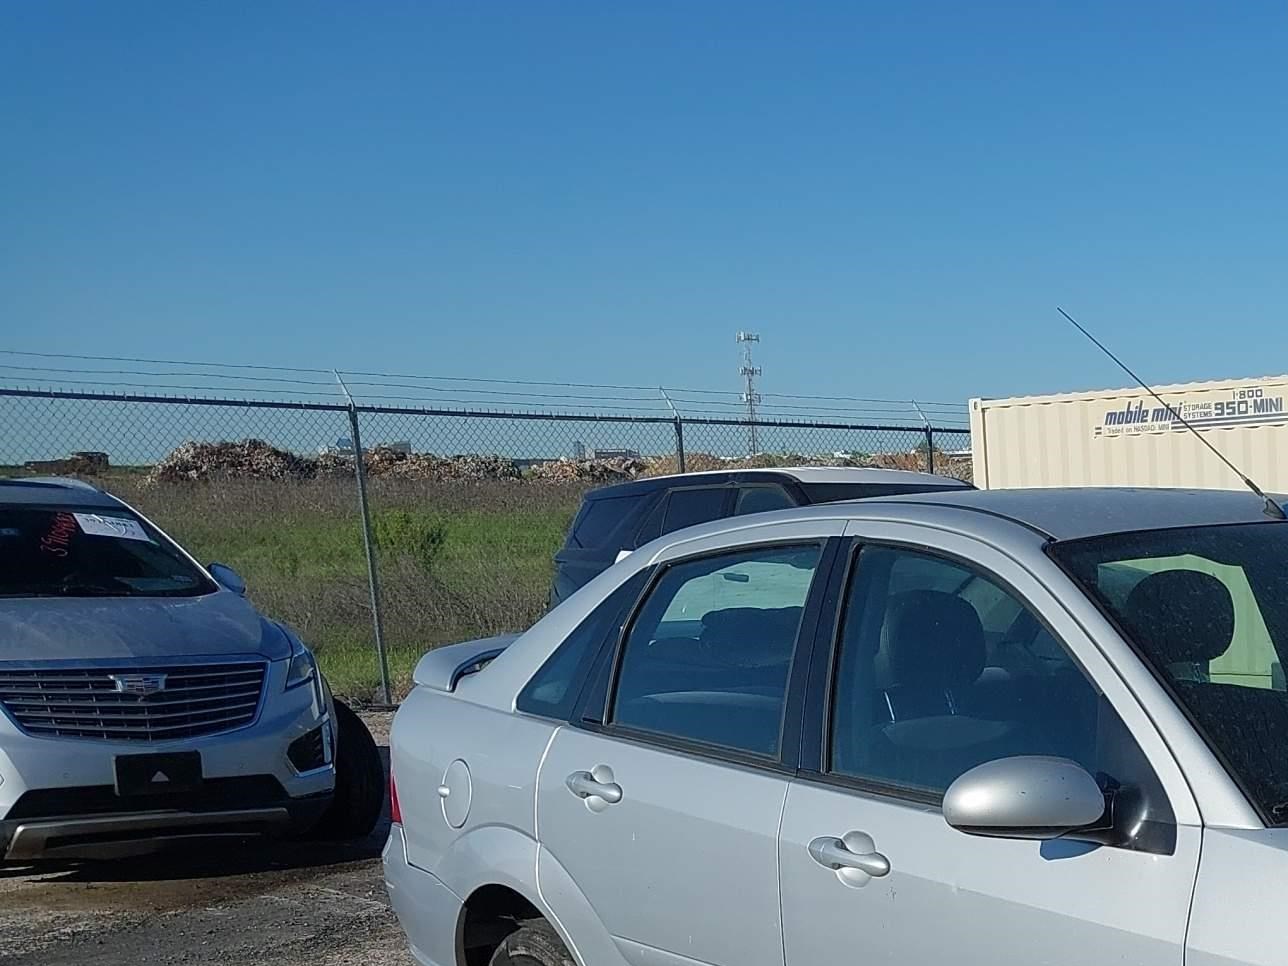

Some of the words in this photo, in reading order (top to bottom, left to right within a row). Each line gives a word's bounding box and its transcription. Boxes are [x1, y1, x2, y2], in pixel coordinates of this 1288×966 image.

[1104, 400, 1149, 426] mobile
[1151, 402, 1183, 423] mini
[1183, 402, 1213, 412] STORAGE
[1214, 397, 1283, 416] 950-MINI
[1183, 410, 1213, 420] SYSTEMS
